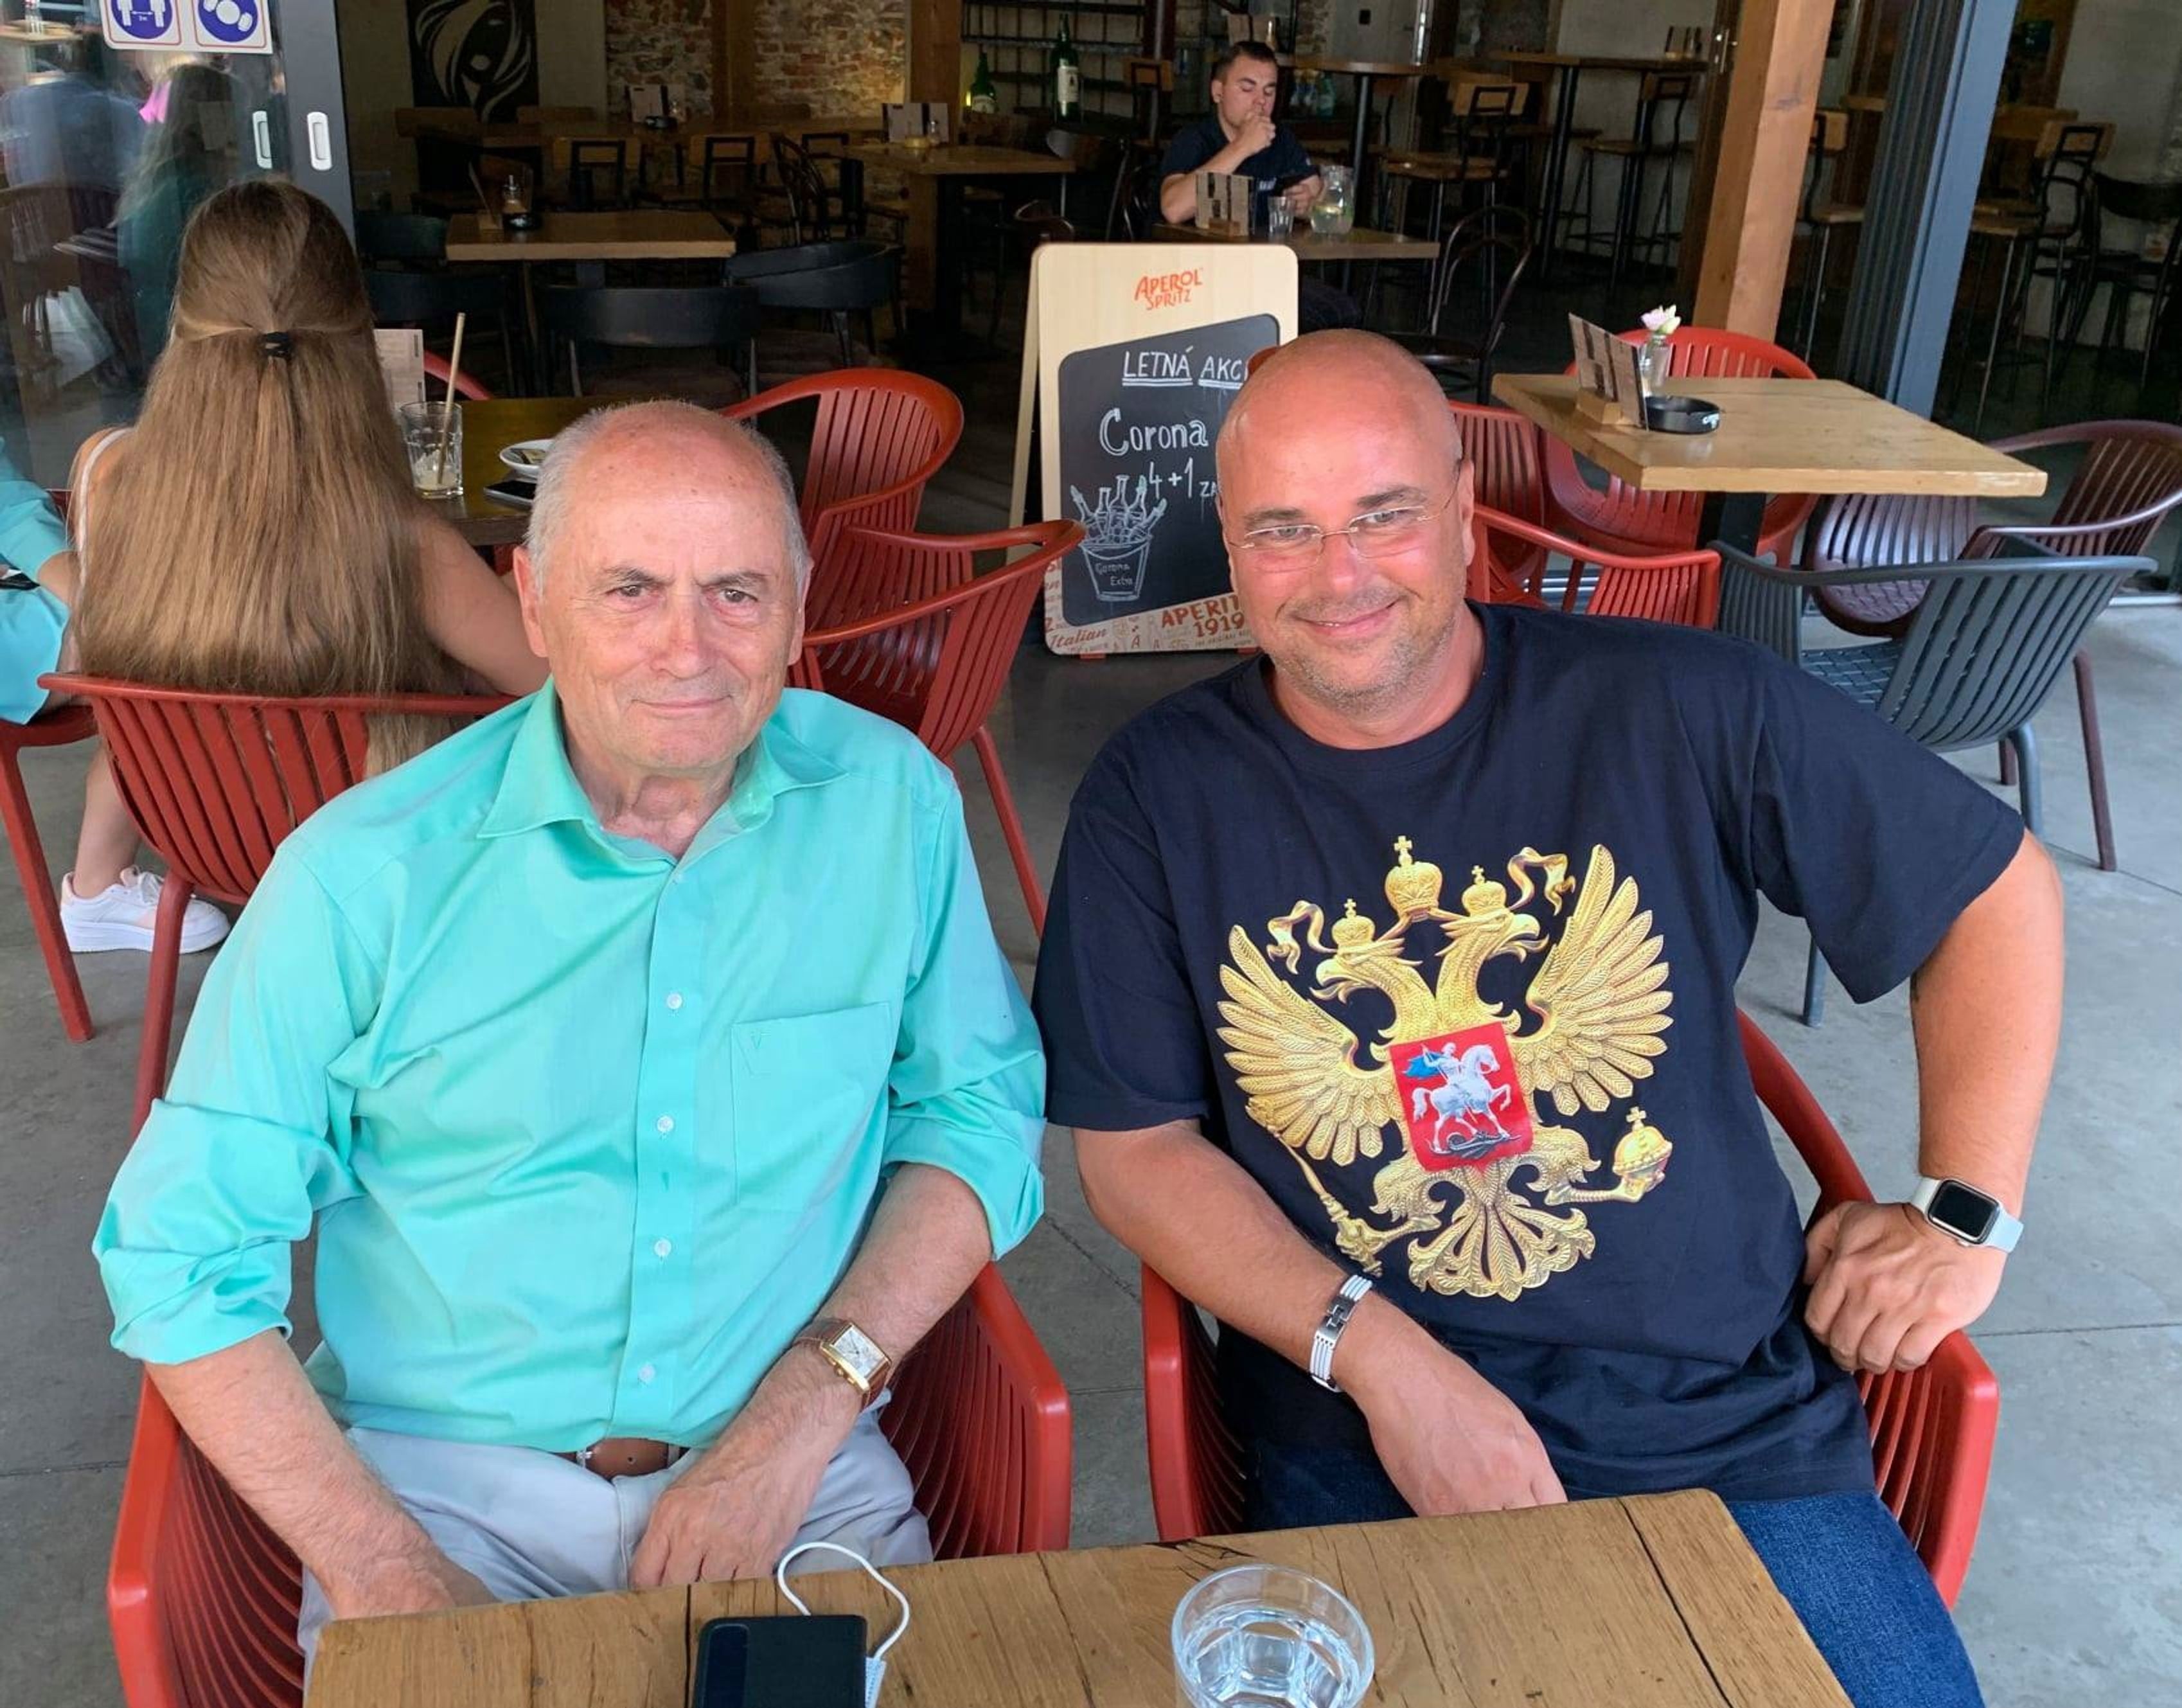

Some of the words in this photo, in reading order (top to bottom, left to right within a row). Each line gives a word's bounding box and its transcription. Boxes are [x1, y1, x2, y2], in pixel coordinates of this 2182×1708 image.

[1134, 269, 1202, 301] APEROL
[1145, 289, 1191, 310] SPRITZ
[1124, 345, 1193, 378] LETNÁ
[1099, 407, 1209, 456] Corona
[1050, 627, 1107, 649] Italian
[1193, 611, 1245, 637] 1919
